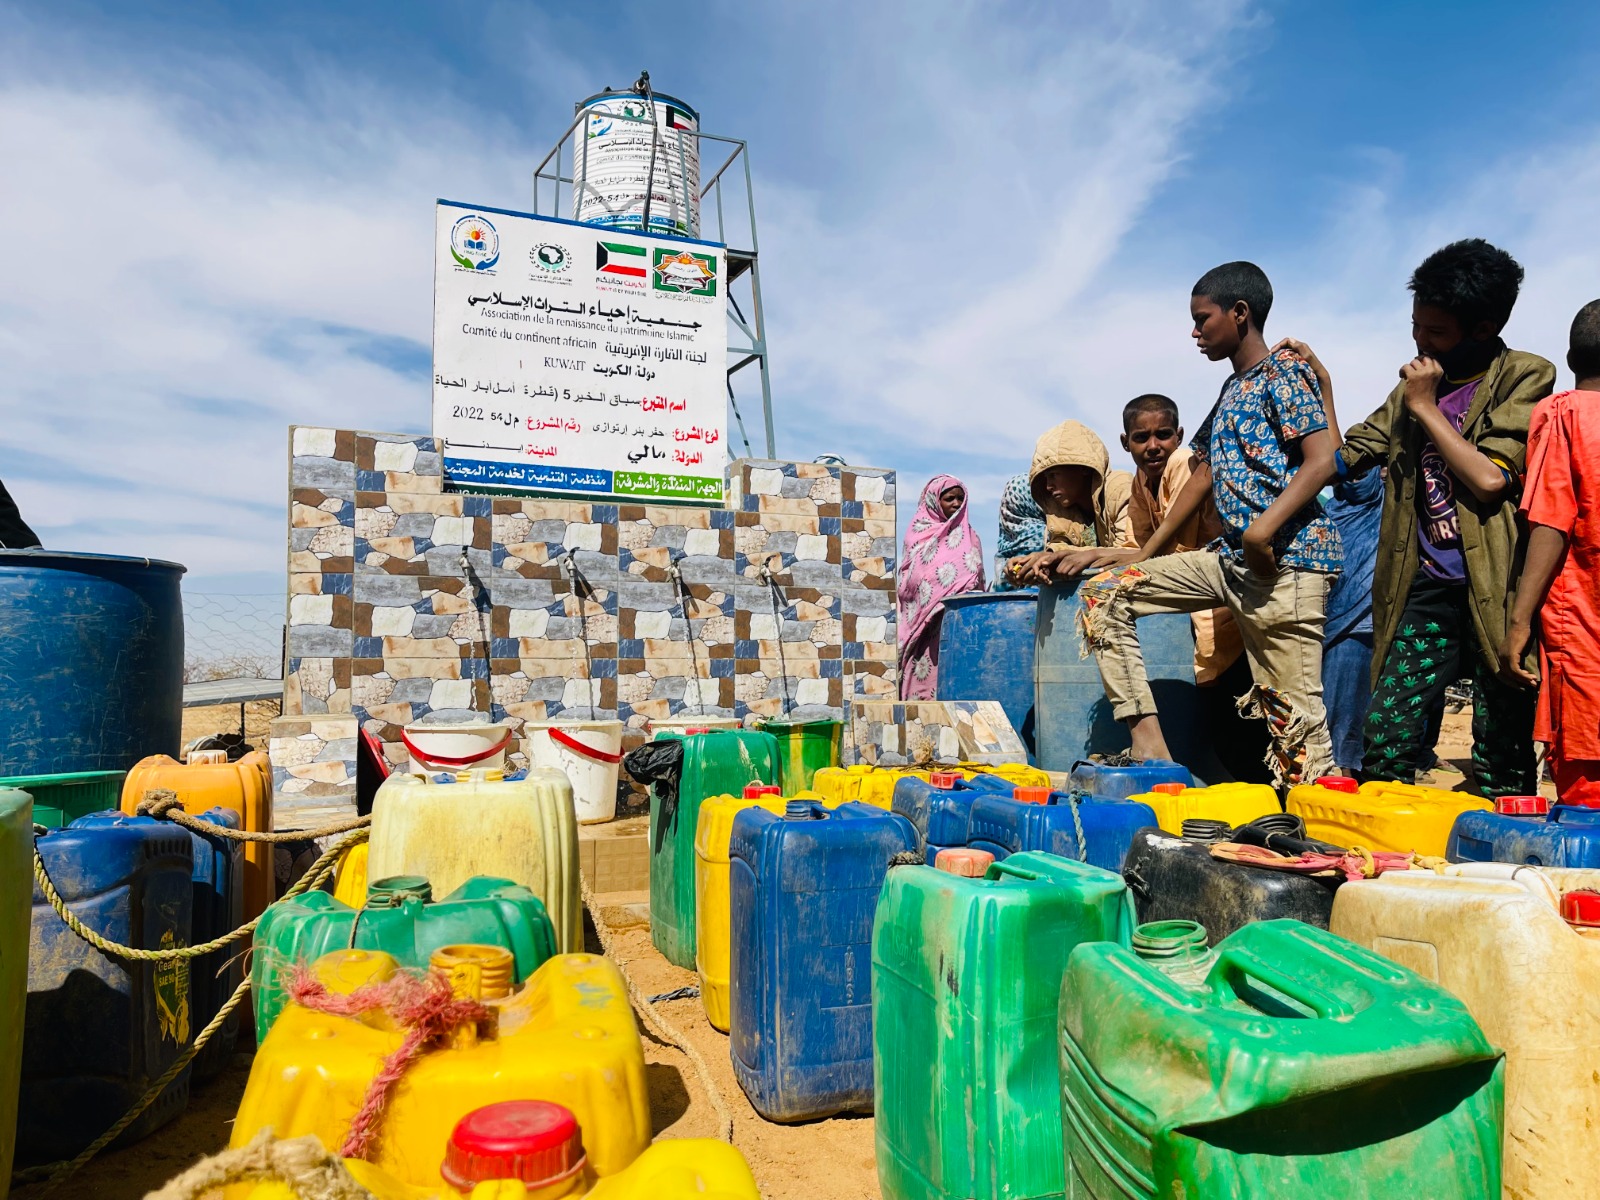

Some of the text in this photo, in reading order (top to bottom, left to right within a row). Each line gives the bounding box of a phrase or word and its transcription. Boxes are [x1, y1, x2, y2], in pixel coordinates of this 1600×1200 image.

[468, 292, 534, 310] الإسلامي
[534, 297, 586, 314] التراث
[588, 299, 630, 324] إحياء
[481, 307, 694, 342] Association de la renaissance du patrimoine Islamic
[462, 323, 597, 350] Comité du continent africain
[654, 346, 682, 362] القارة
[686, 350, 707, 366] لجنة
[544, 357, 586, 372] KUWAIT
[593, 363, 656, 381] دولة الكويت
[435, 374, 467, 388] الحياة
[563, 389, 571, 400] 5
[573, 391, 606, 404] الخير
[452, 405, 484, 421] 2022
[669, 398, 686, 414] اسم
[564, 418, 582, 433] رقم
[627, 444, 666, 464] مالي
[528, 468, 568, 484] التنمية
[158, 961, 174, 973] Gea
